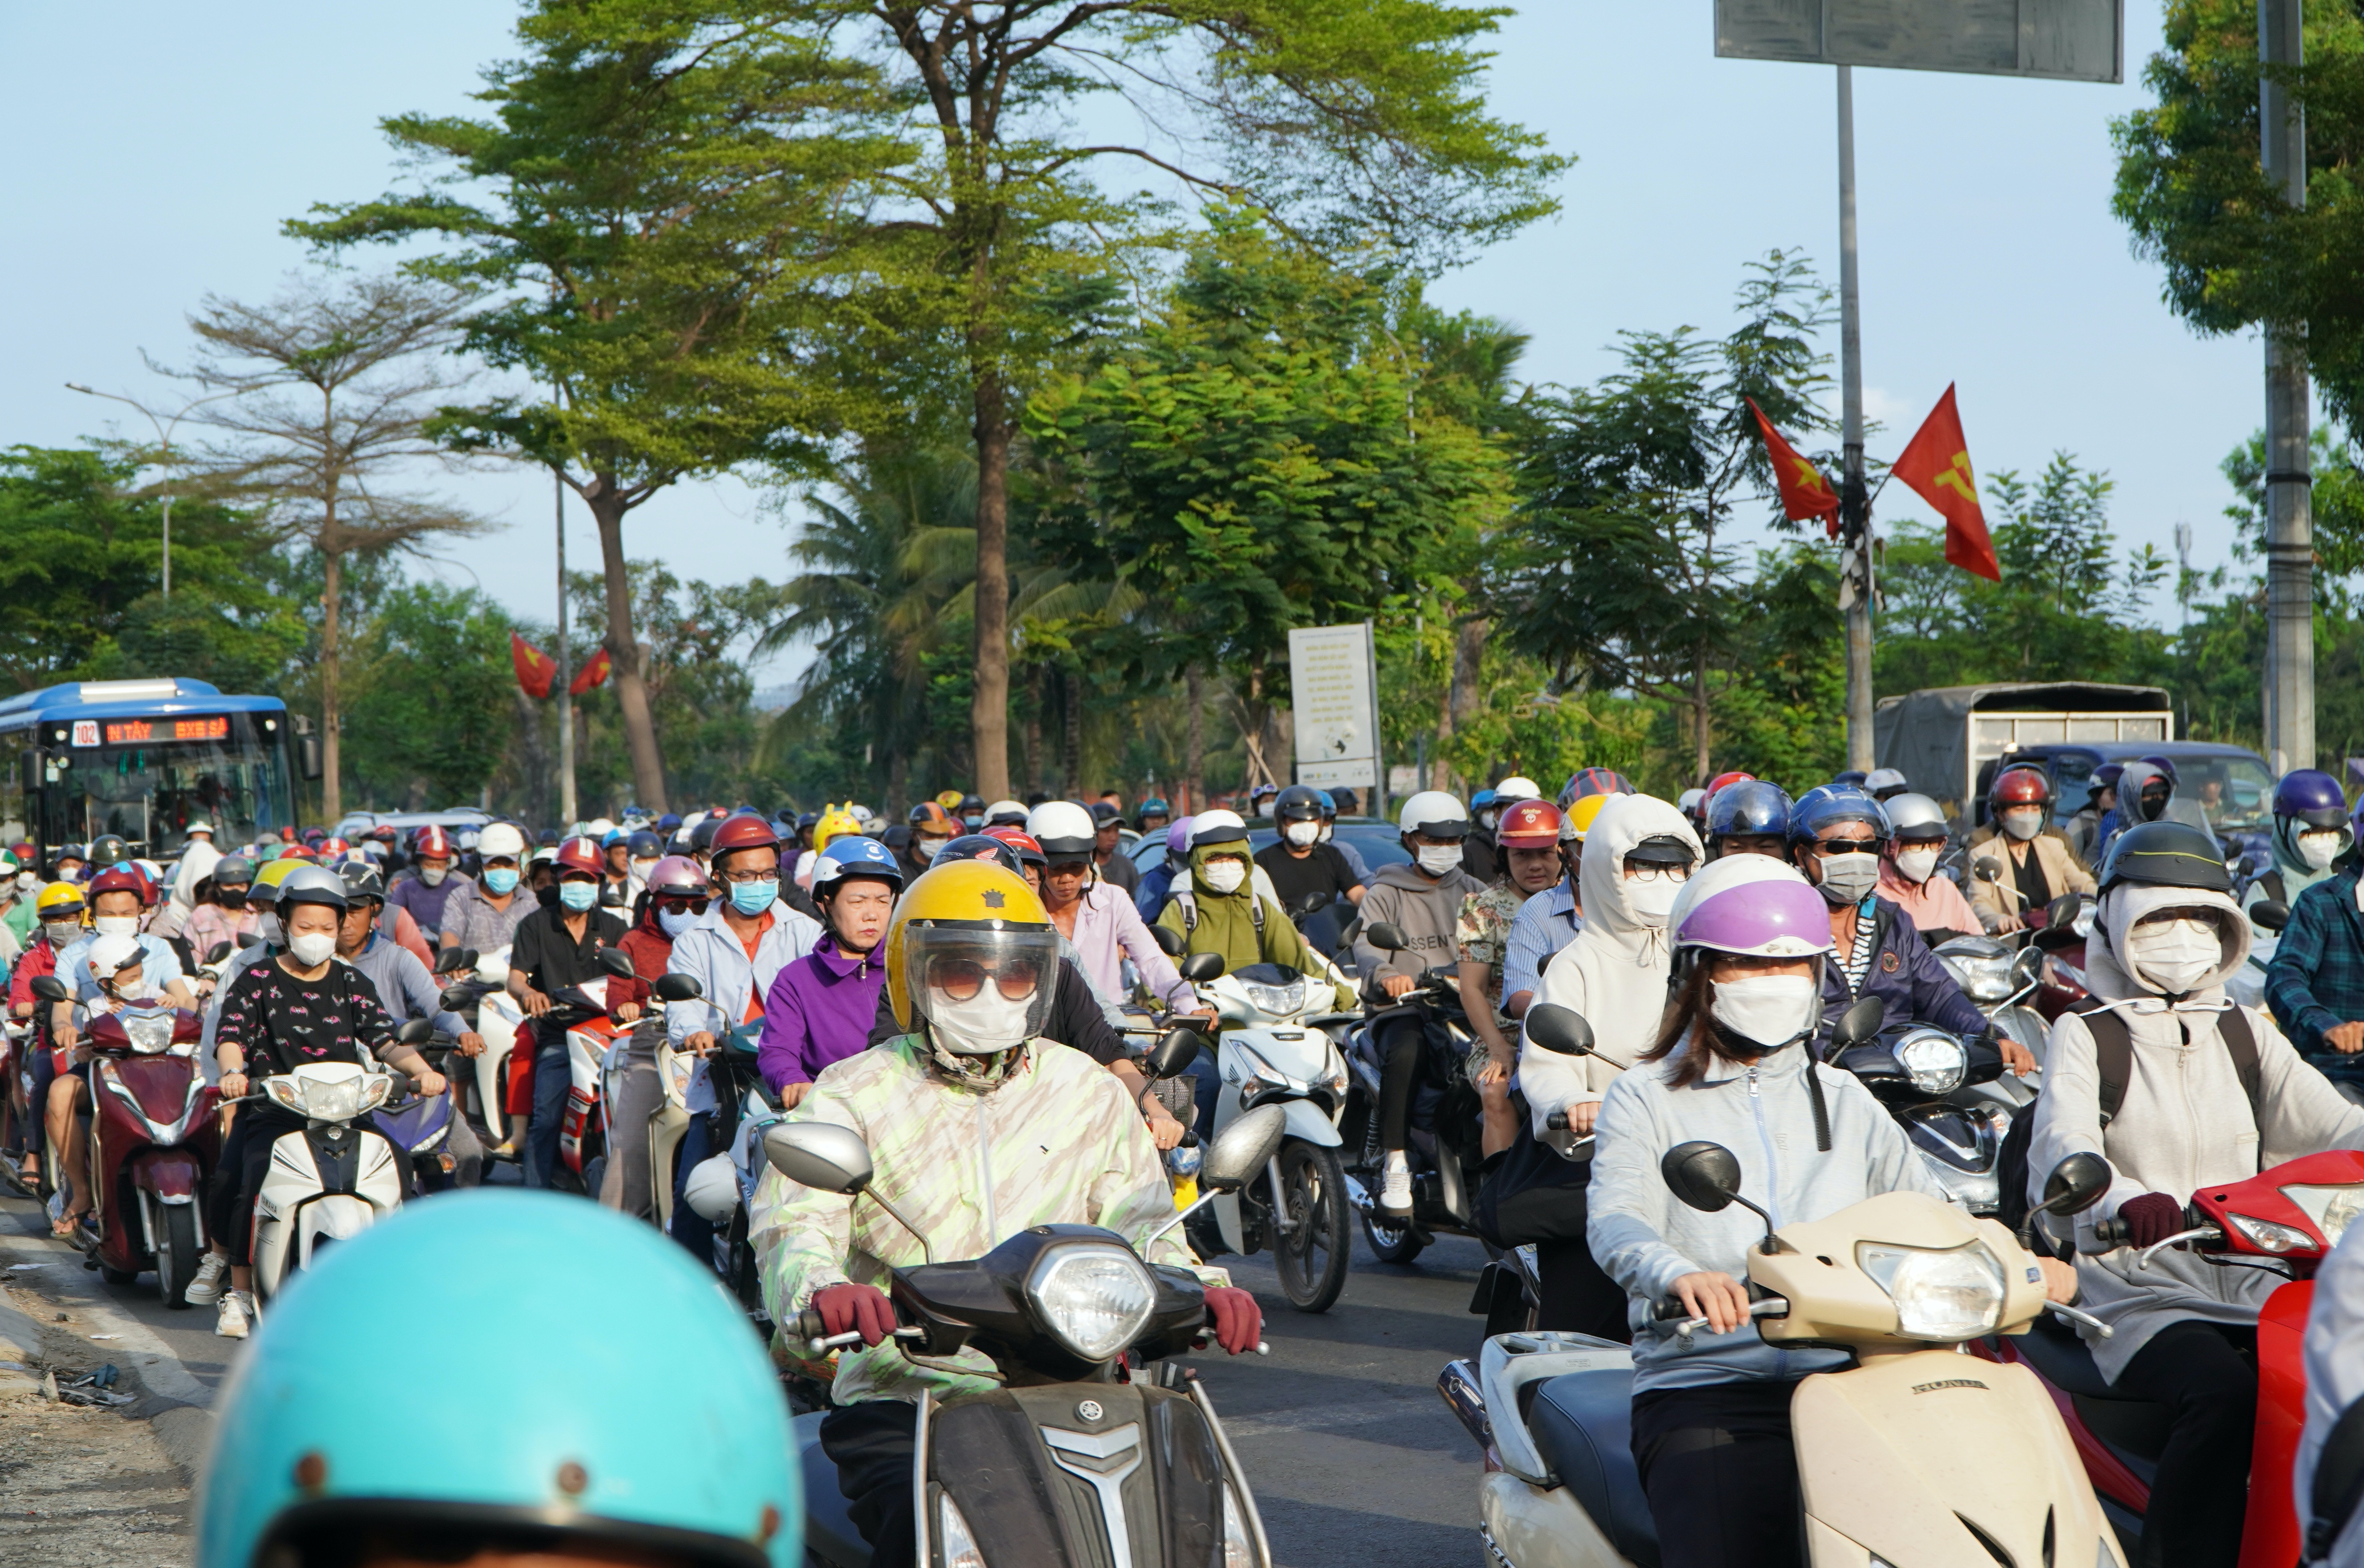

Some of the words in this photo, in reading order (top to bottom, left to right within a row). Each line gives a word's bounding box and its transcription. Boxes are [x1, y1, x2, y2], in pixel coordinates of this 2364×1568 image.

[75, 725, 95, 744] 102
[261, 1195, 277, 1215] YAMAHA
[1911, 1379, 1990, 1395] HONDA
